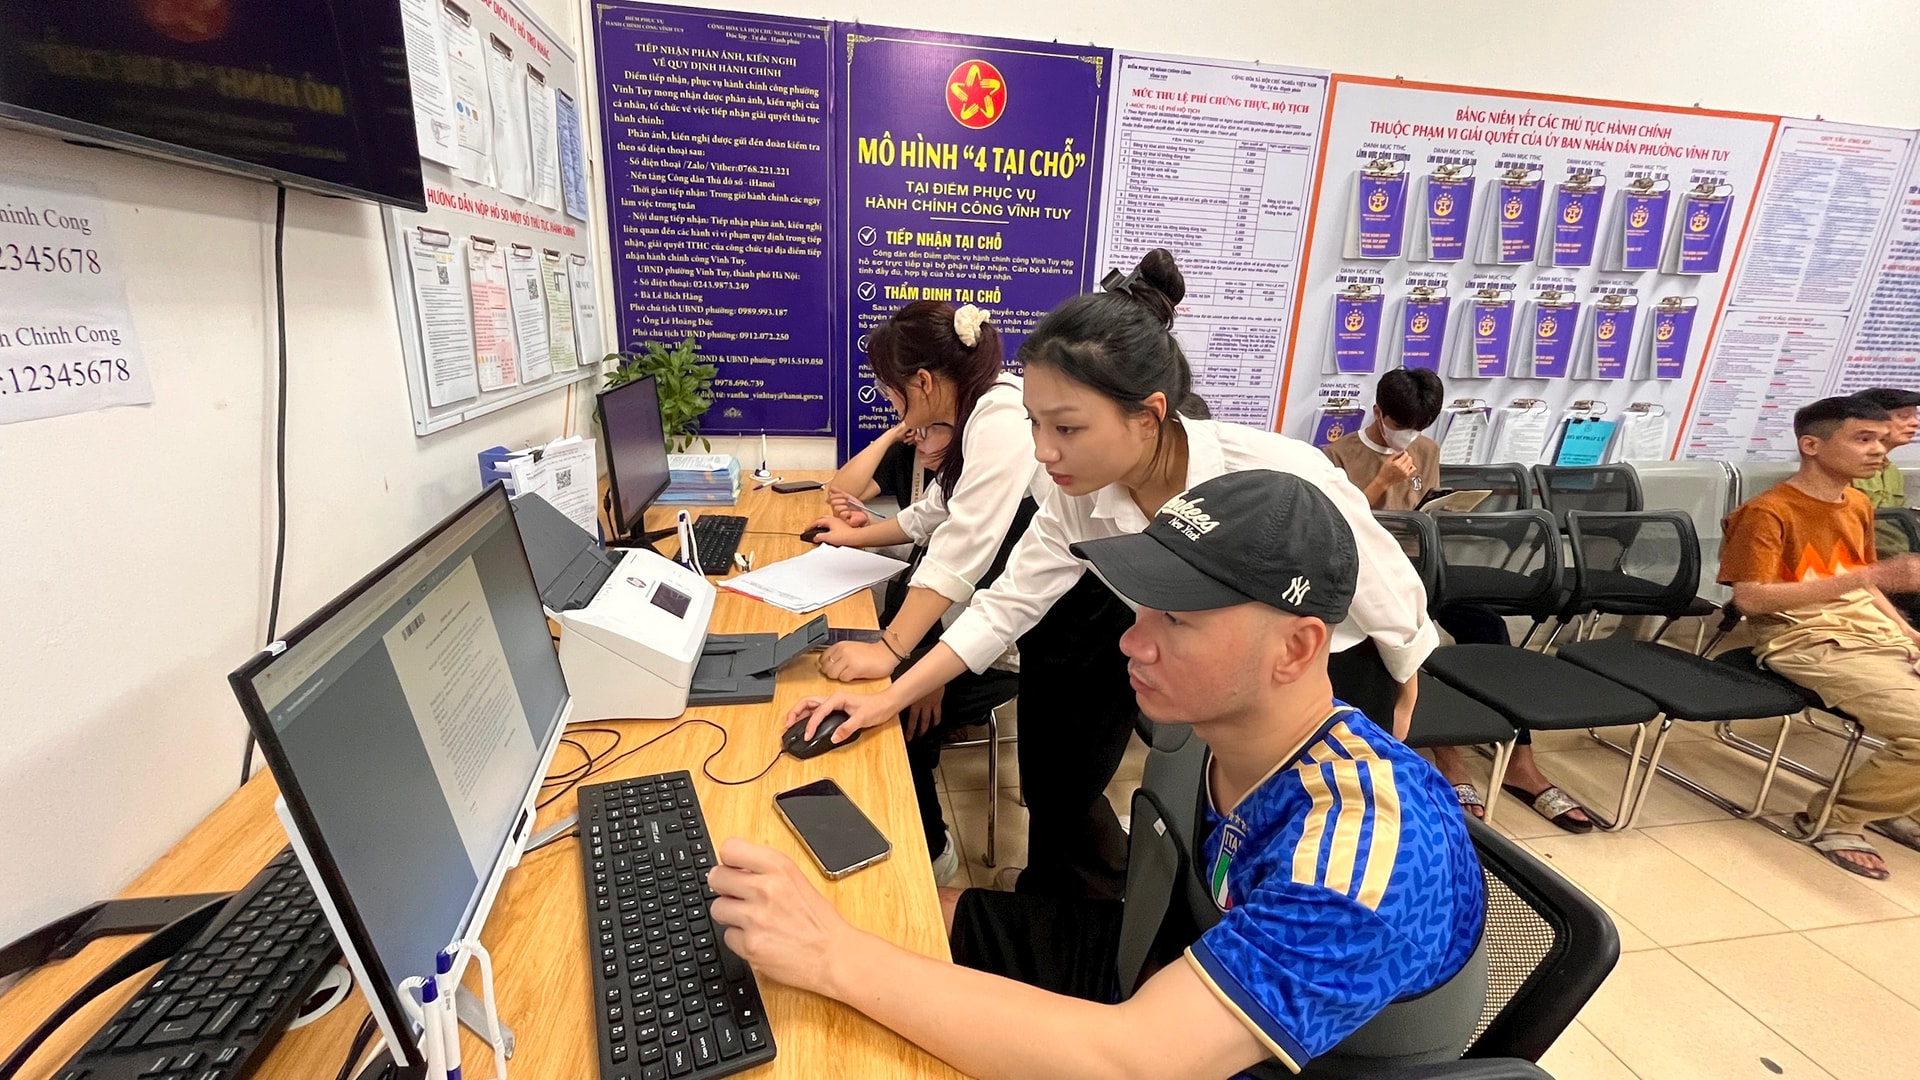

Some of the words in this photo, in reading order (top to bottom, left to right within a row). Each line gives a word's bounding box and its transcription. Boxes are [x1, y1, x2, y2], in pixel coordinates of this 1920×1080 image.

[635, 42, 658, 53] TIẾP
[660, 45, 689, 56] NHẬN
[691, 48, 719, 58] PHẢN
[720, 50, 745, 61] ÁNH,
[746, 53, 769, 63] KIẾN
[771, 56, 796, 67] NGHỊ
[652, 57, 666, 67] VỀ
[667, 59, 688, 70] QUY
[690, 61, 716, 71] ĐỊNH
[718, 64, 747, 74] HÀNH
[748, 67, 781, 77] CHÍNH
[1132, 87, 1153, 98] MỨC
[1156, 90, 1175, 100] THU
[1176, 91, 1188, 104] LỆ
[1190, 94, 1207, 103] PHÍ
[1209, 95, 1241, 107] CHỨNG
[1244, 99, 1270, 111] THỰC,
[1272, 101, 1286, 113] HỘ
[1288, 103, 1309, 114] TỊCH
[1455, 105, 1486, 123] BẢNG
[1487, 109, 1516, 126] NIÊM
[1518, 108, 1536, 126] YẾT
[1537, 113, 1559, 129] CÁC
[1561, 115, 1583, 131] THỦ
[1584, 120, 1605, 135] TỤC
[1606, 119, 1637, 136] HÀNH
[1638, 123, 1672, 139] CHÍNH
[1370, 119, 1411, 139] THUỘC
[1412, 124, 1444, 141] PHẠM
[1447, 127, 1458, 140] VI
[1459, 125, 1483, 141] GIẢI
[1484, 124, 1520, 145] QUYẾT
[1521, 130, 1542, 146] CỦA
[1544, 131, 1560, 147] ỦY
[1560, 136, 1582, 149] BAN
[1583, 137, 1614, 152] NHÂN
[1614, 139, 1637, 154] DÂN
[1638, 142, 1683, 158] PHƯỜNG
[1711, 149, 1730, 161] TUY
[858, 130, 895, 166] MÔ
[900, 132, 958, 170] HÌNH
[992, 147, 1025, 181] TẠI
[905, 180, 929, 196] TẠI
[932, 182, 969, 196] ĐIỂM
[973, 185, 1012, 201] PHỤC
[1016, 188, 1036, 203] VỤ
[865, 194, 907, 210] HÀNH
[911, 197, 957, 213] CHÍNH
[961, 200, 1003, 216] CÔNG
[1007, 203, 1040, 218] VĨNH
[1044, 207, 1071, 220] TUY
[44, 208, 92, 236] Cong
[885, 227, 913, 245] TIẾP
[916, 230, 952, 250] NHẬN
[954, 234, 974, 251] TẠI
[977, 231, 1002, 250] CHỖ
[637, 264, 664, 273] UBND
[883, 281, 919, 300] THẨM
[954, 288, 974, 305] TẠI
[976, 285, 1001, 303] CHỖ
[678, 304, 704, 313] UBND
[15, 325, 73, 347] Chinh
[75, 325, 122, 346] Cong
[1281, 576, 1311, 606] NY
